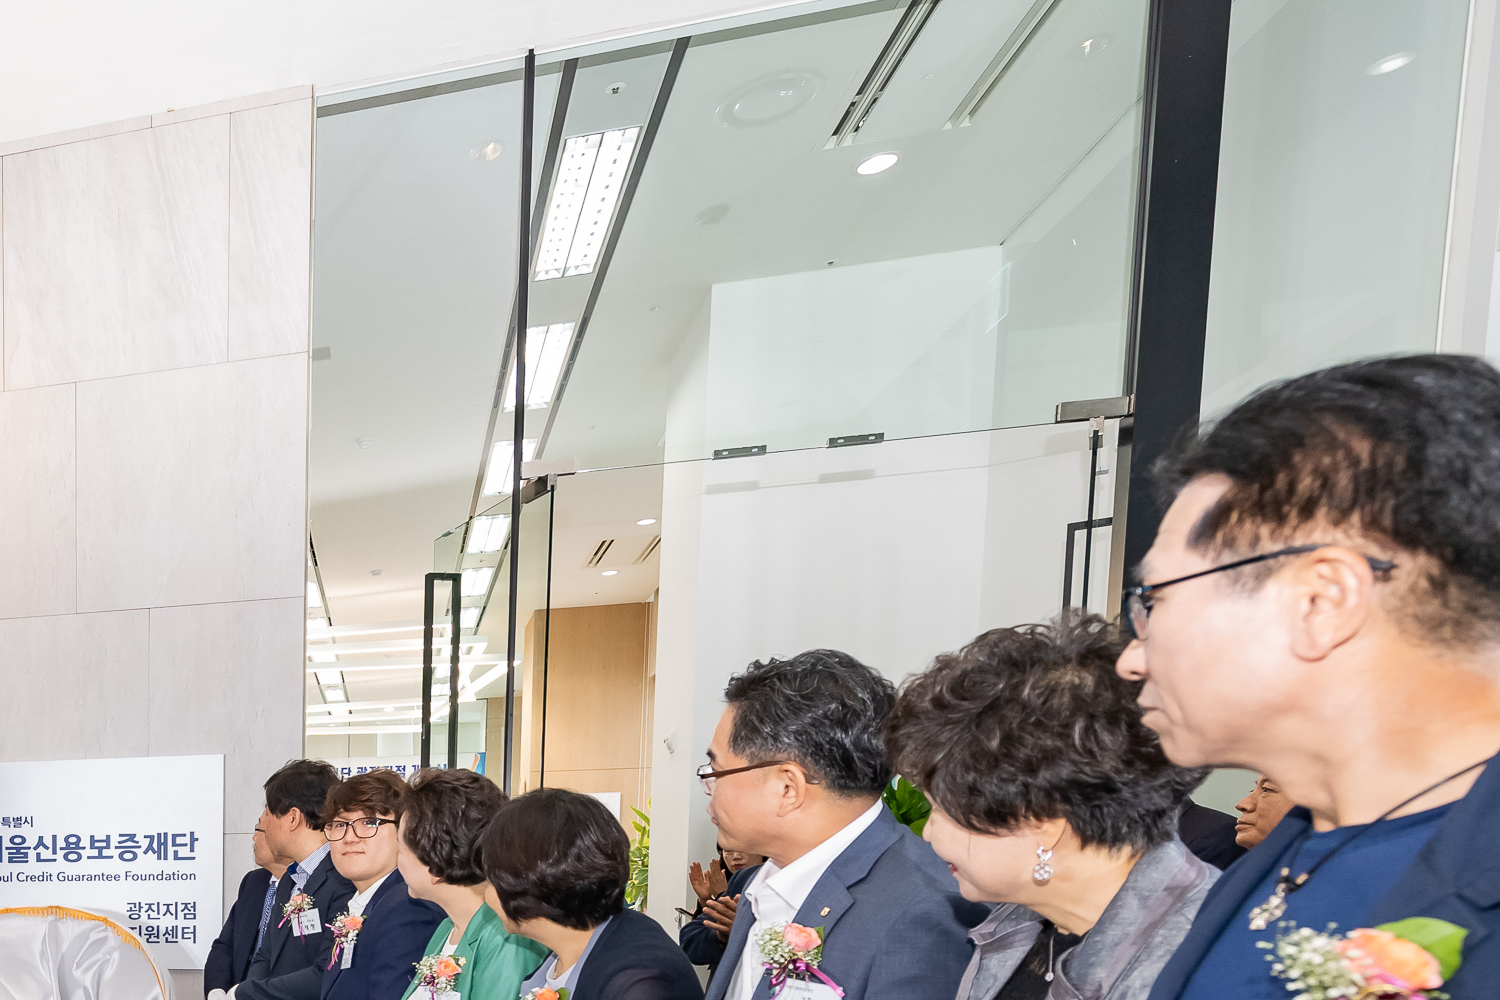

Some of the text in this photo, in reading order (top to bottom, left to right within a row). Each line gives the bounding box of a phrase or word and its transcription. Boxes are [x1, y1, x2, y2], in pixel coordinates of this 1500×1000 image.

[16, 871, 53, 882] Credit
[56, 871, 121, 882] Guarantee
[125, 870, 197, 881] Foundation
[126, 901, 197, 920] 광진지점
